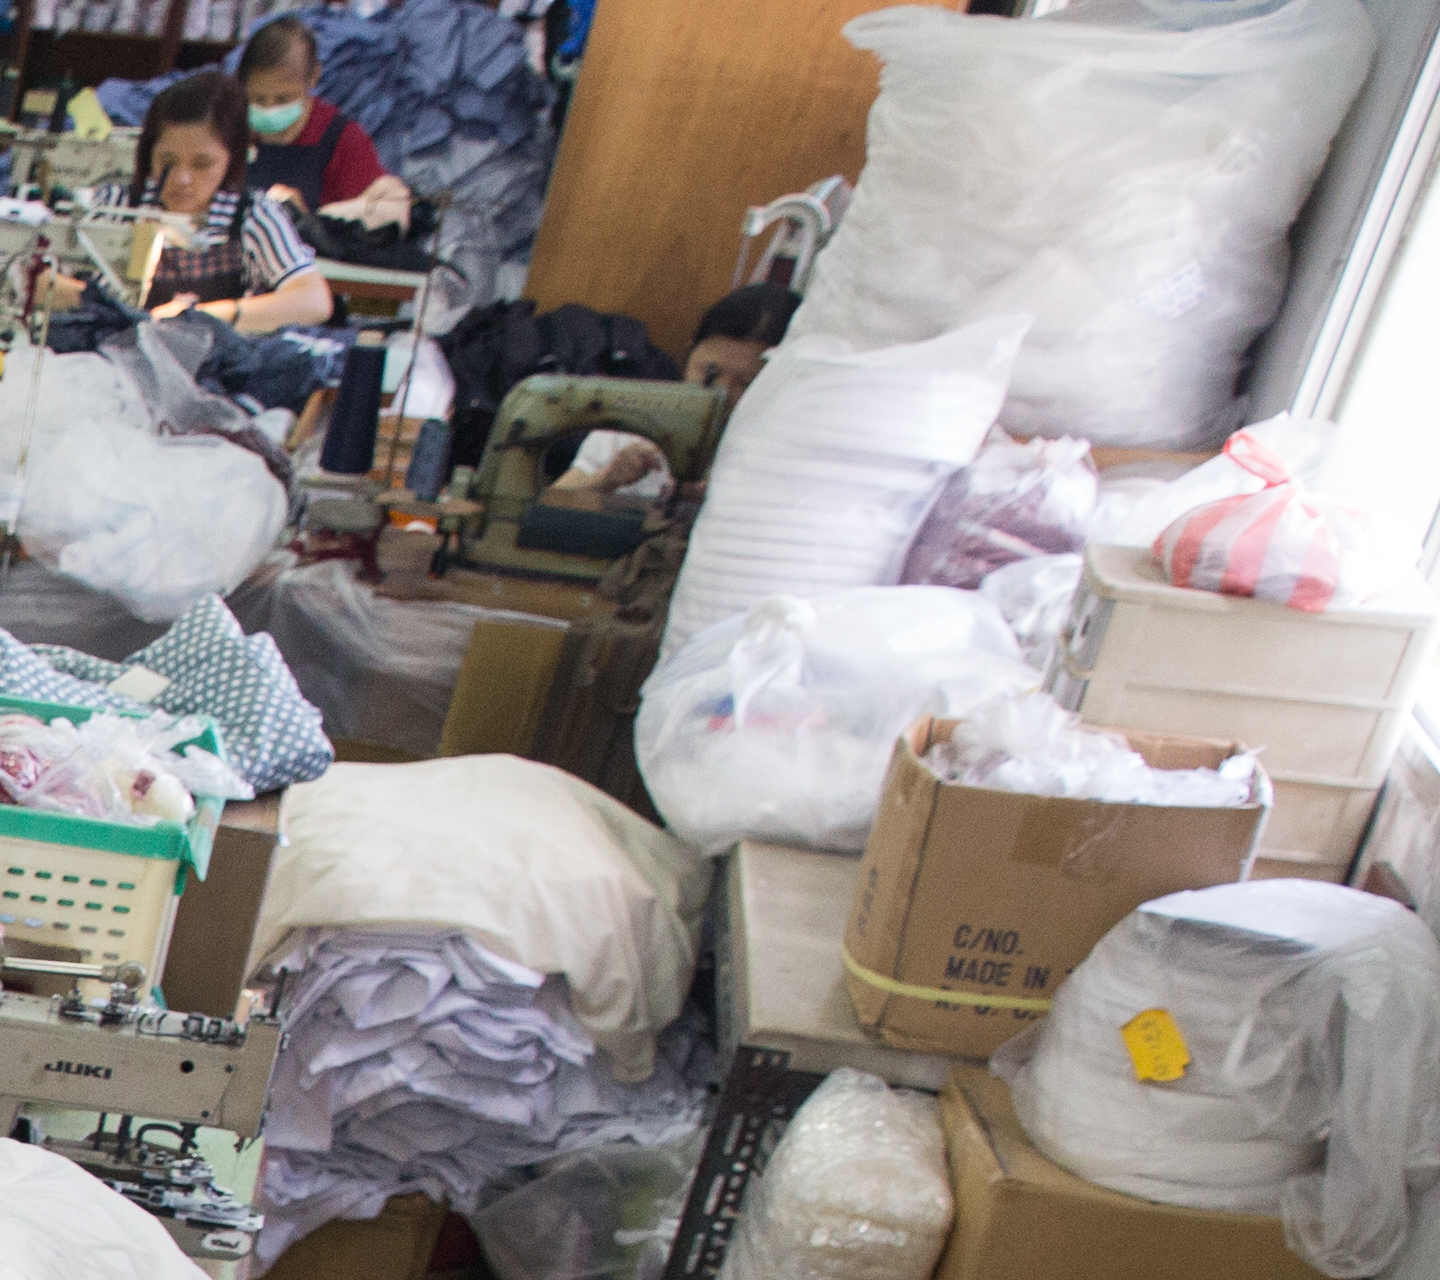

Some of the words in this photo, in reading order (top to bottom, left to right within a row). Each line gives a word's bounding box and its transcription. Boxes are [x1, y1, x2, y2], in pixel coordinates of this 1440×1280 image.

[953, 924, 1025, 956] C/NO.
[944, 955, 1013, 986] MADE
[1023, 966, 1051, 990] IN
[44, 1060, 113, 1080] JUKI
